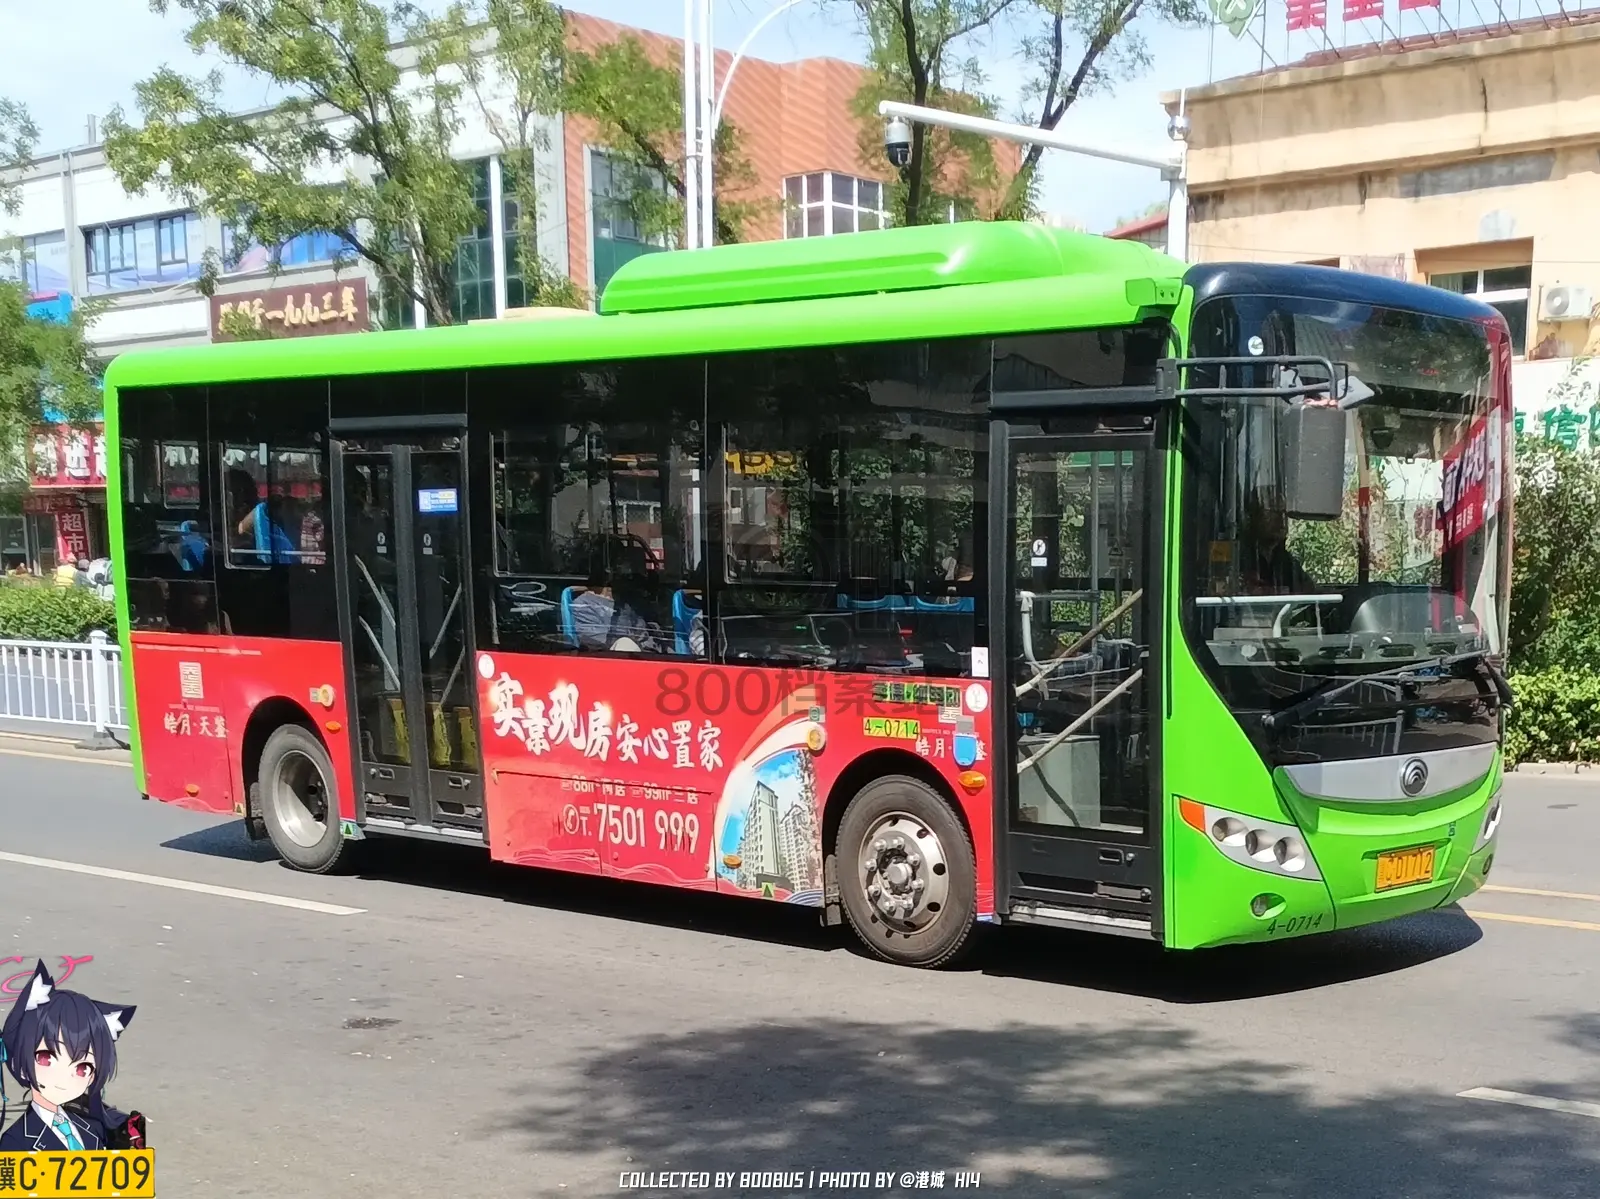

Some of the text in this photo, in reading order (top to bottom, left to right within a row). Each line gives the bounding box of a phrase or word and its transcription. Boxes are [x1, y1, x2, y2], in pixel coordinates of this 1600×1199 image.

[61, 513, 85, 552] 超市
[864, 719, 920, 738] 4-0714
[594, 803, 646, 848] 7501
[654, 809, 700, 854] 999
[1266, 913, 1324, 935] 4-0714
